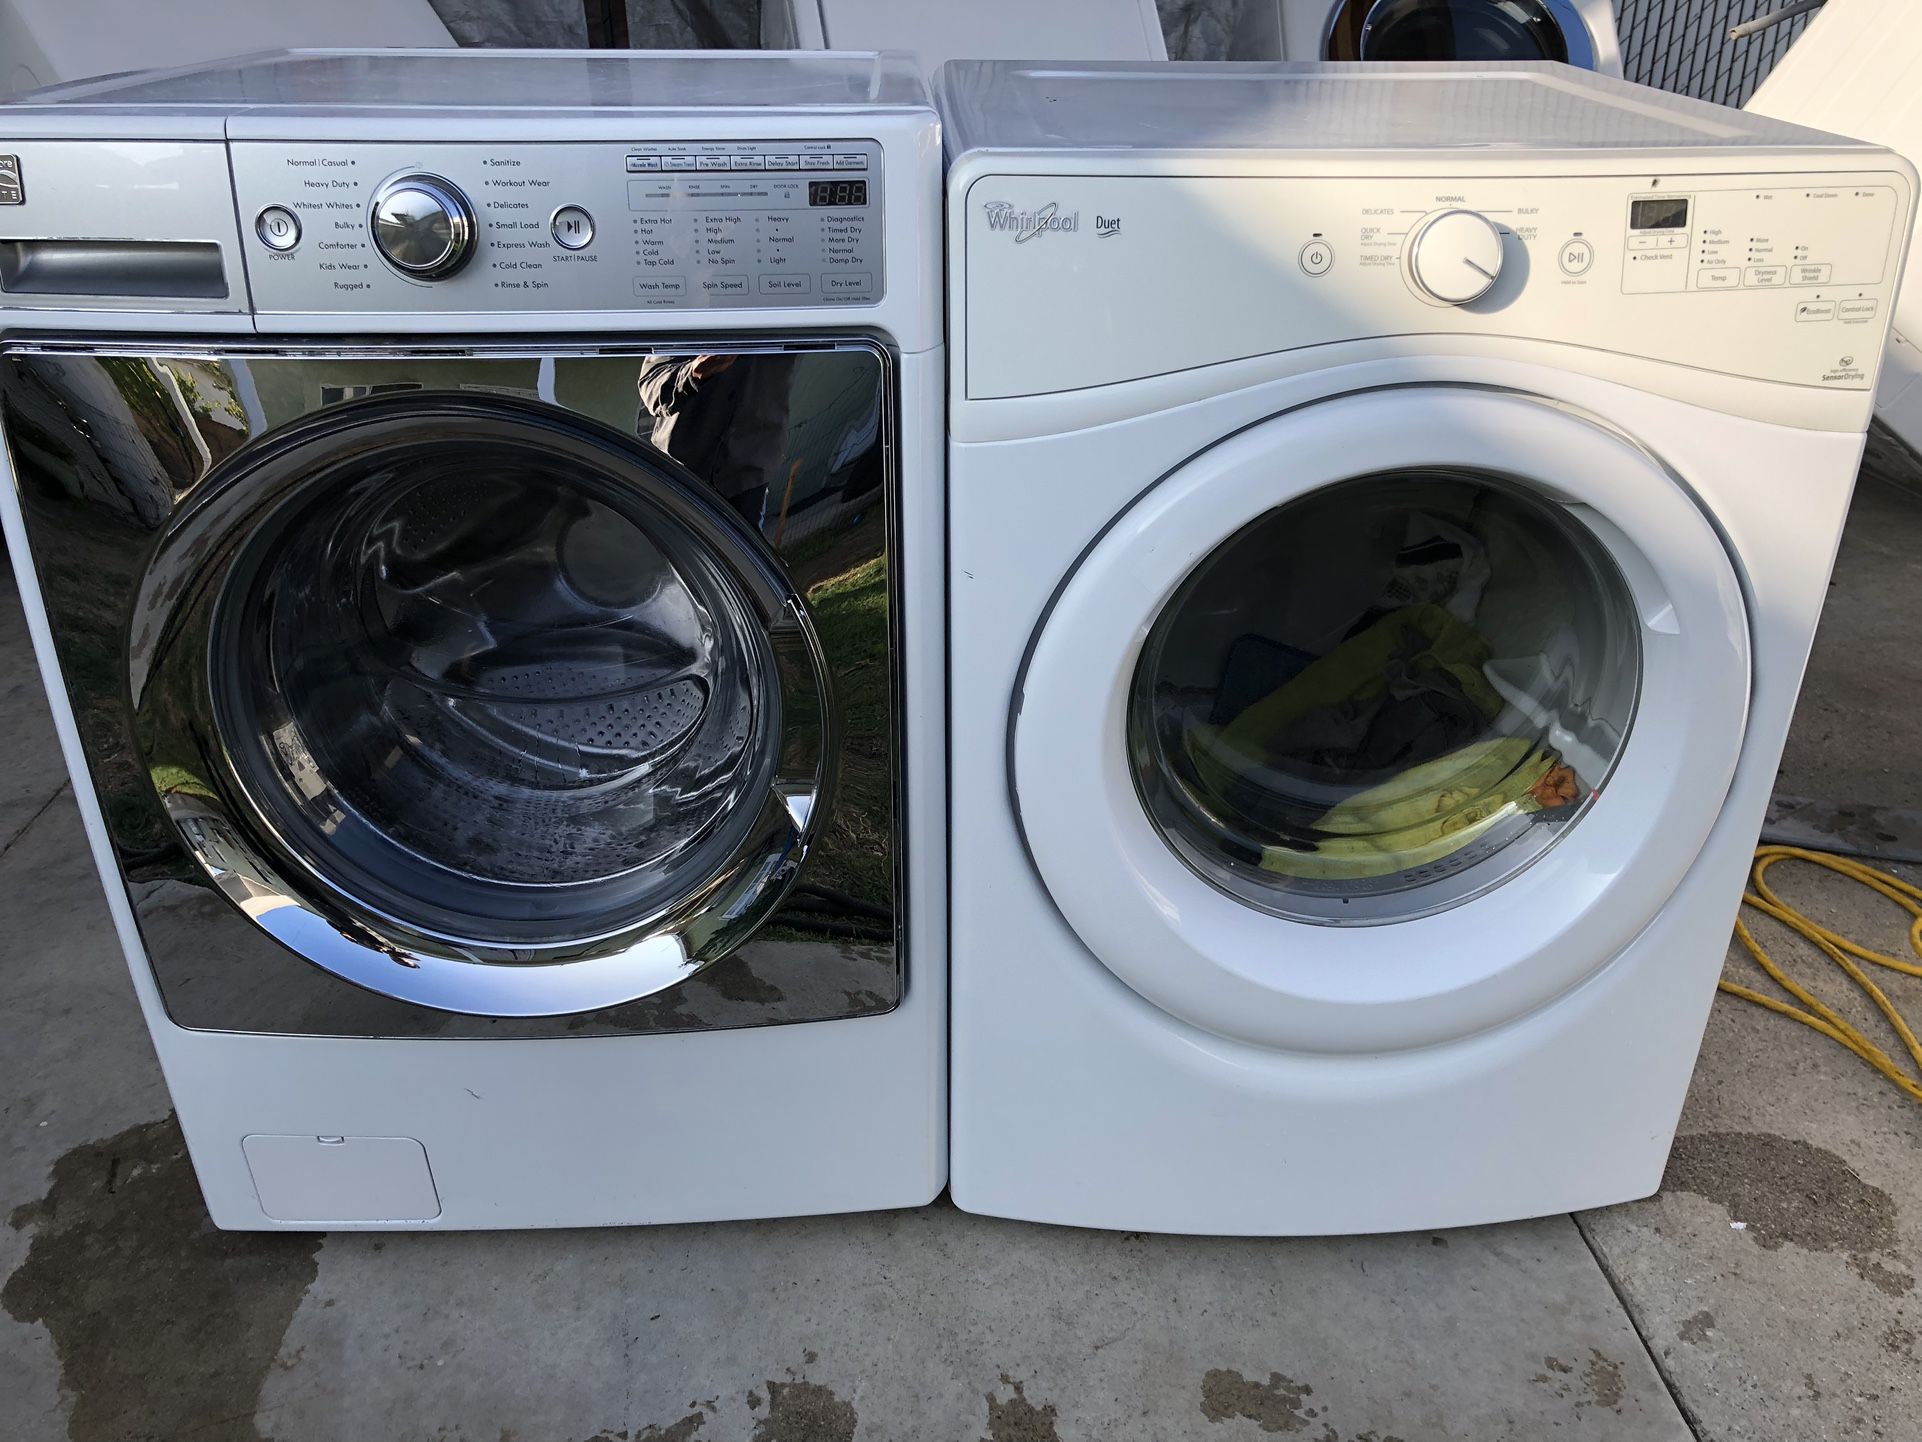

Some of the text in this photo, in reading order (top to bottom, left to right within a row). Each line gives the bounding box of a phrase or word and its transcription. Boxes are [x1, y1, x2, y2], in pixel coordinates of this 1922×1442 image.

[725, 216, 741, 224] High
[984, 204, 1120, 241] Whirlpool Duet
[335, 222, 354, 230] Bulky
[334, 282, 363, 290] Rugged
[662, 282, 680, 290] Temp
